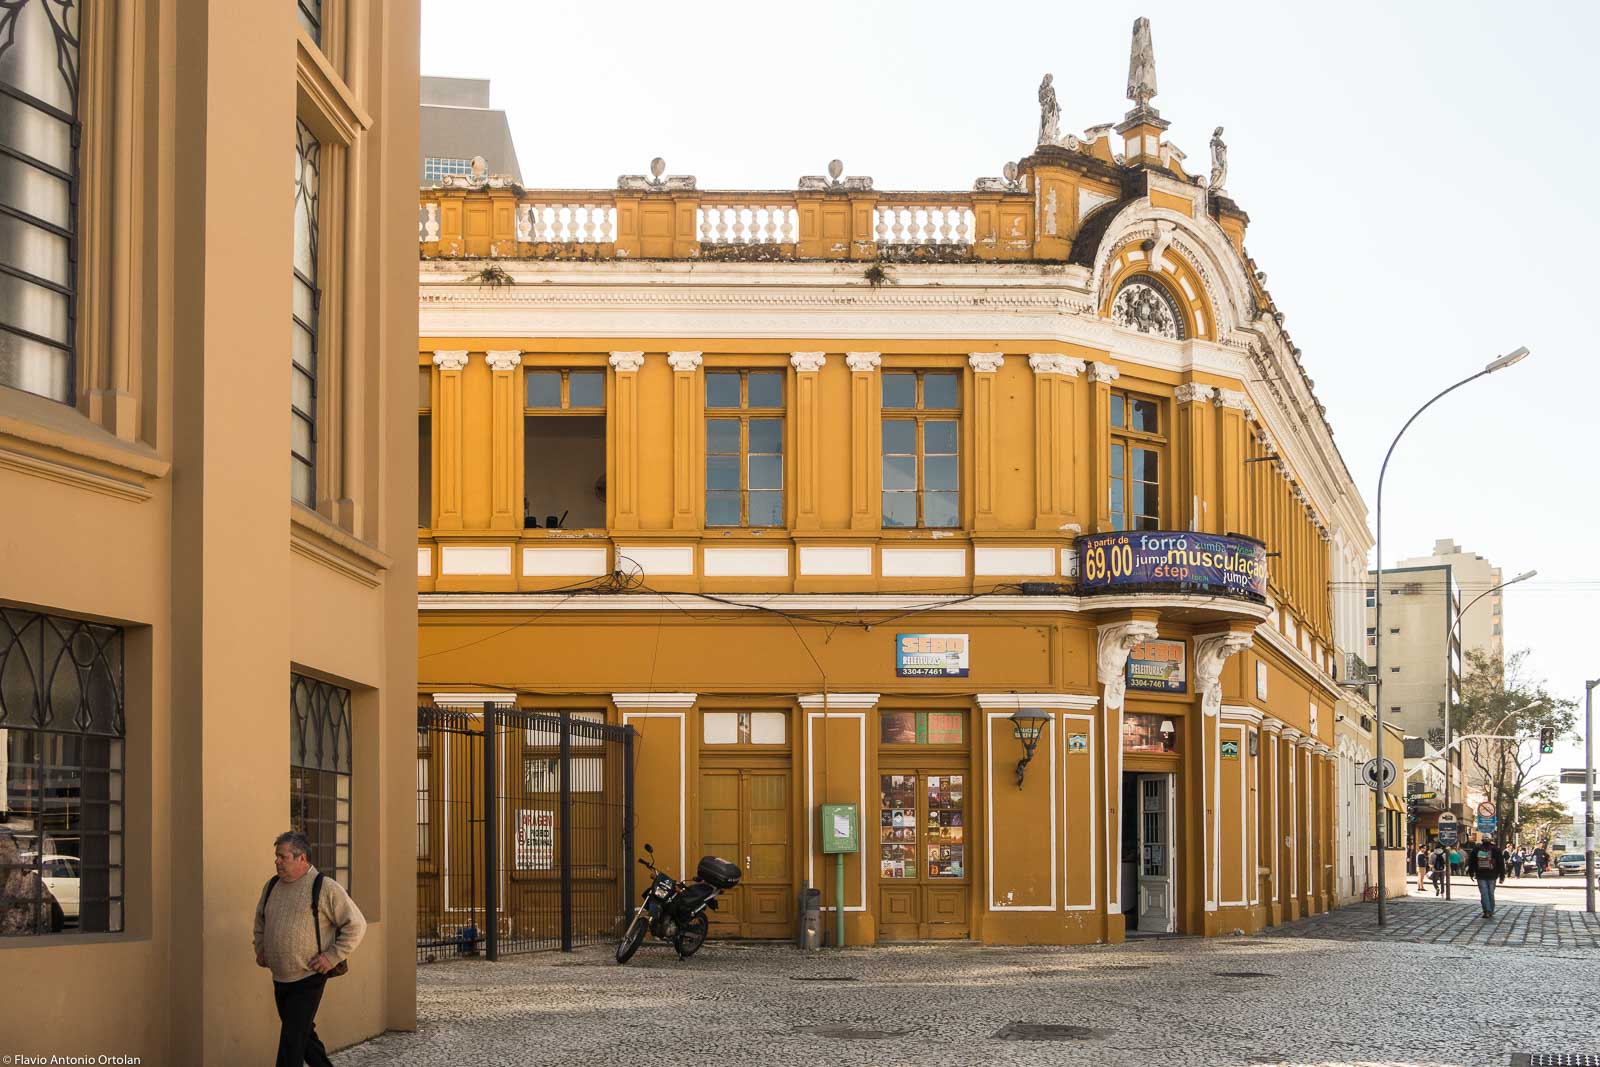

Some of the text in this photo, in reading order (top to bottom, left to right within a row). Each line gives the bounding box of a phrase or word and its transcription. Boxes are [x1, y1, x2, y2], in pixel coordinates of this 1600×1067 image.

[1094, 537, 1116, 549] partir
[1118, 536, 1129, 545] de
[1140, 535, 1187, 551] forró
[1086, 544, 1133, 584] 69,00
[1135, 554, 1168, 568] jump
[1167, 549, 1266, 580] musculação
[1154, 565, 1189, 581] step
[1223, 569, 1248, 587] jump
[901, 637, 964, 654] SEBO
[1130, 641, 1183, 664] SEBO
[1131, 664, 1164, 676] RELEITURAS
[1131, 679, 1165, 688] 3304-7461
